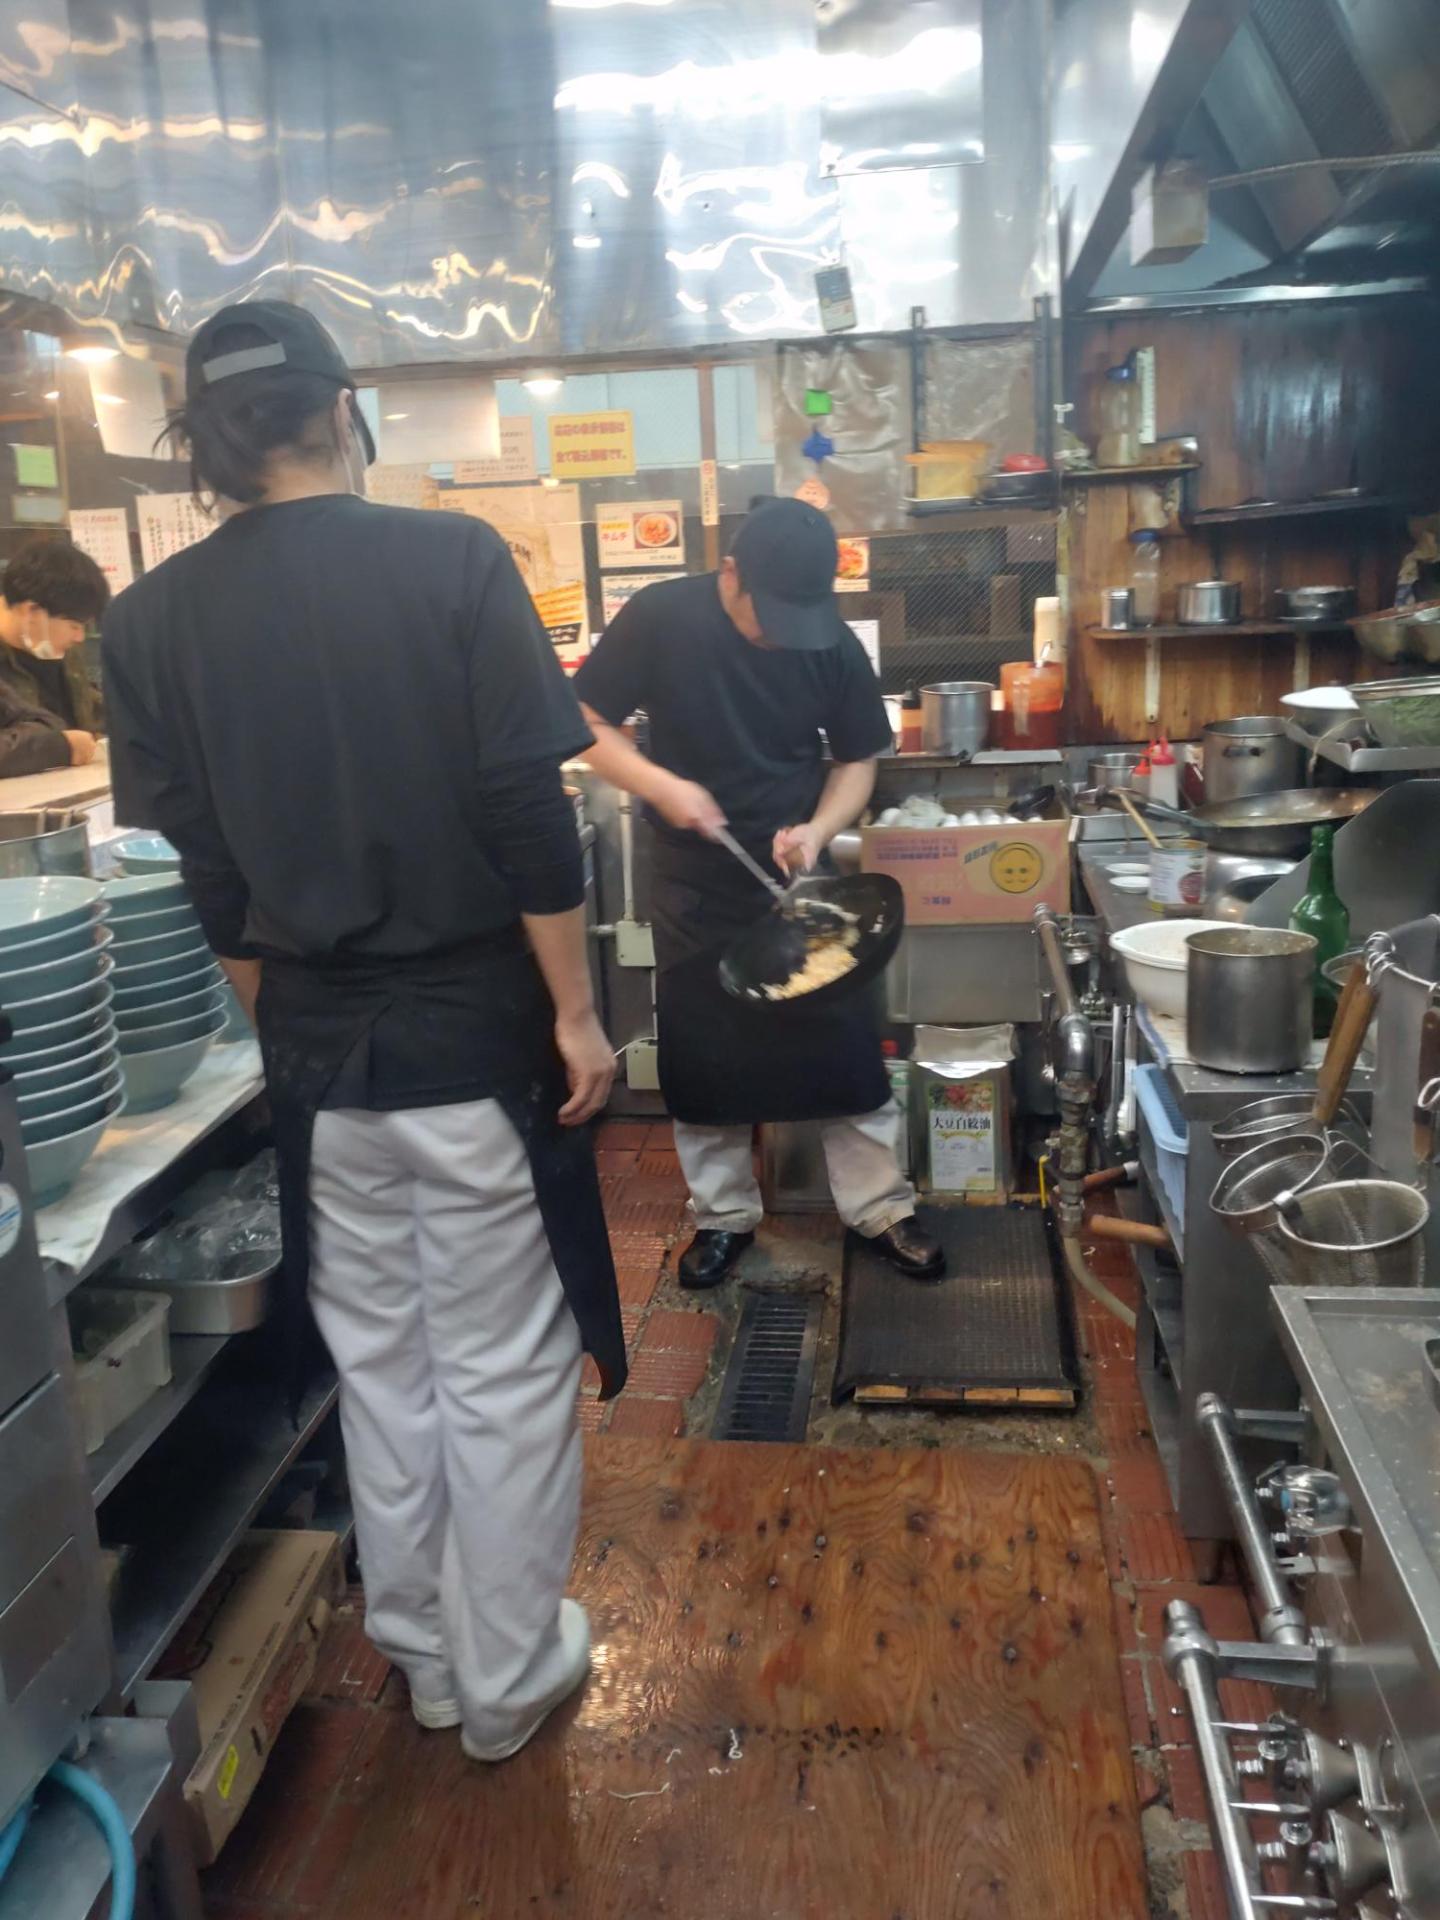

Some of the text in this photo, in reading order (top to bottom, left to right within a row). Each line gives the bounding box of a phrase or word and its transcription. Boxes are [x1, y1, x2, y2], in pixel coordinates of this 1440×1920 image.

[601, 531, 627, 542] キムチ
[933, 1116, 991, 1131] 大豆白絞油
